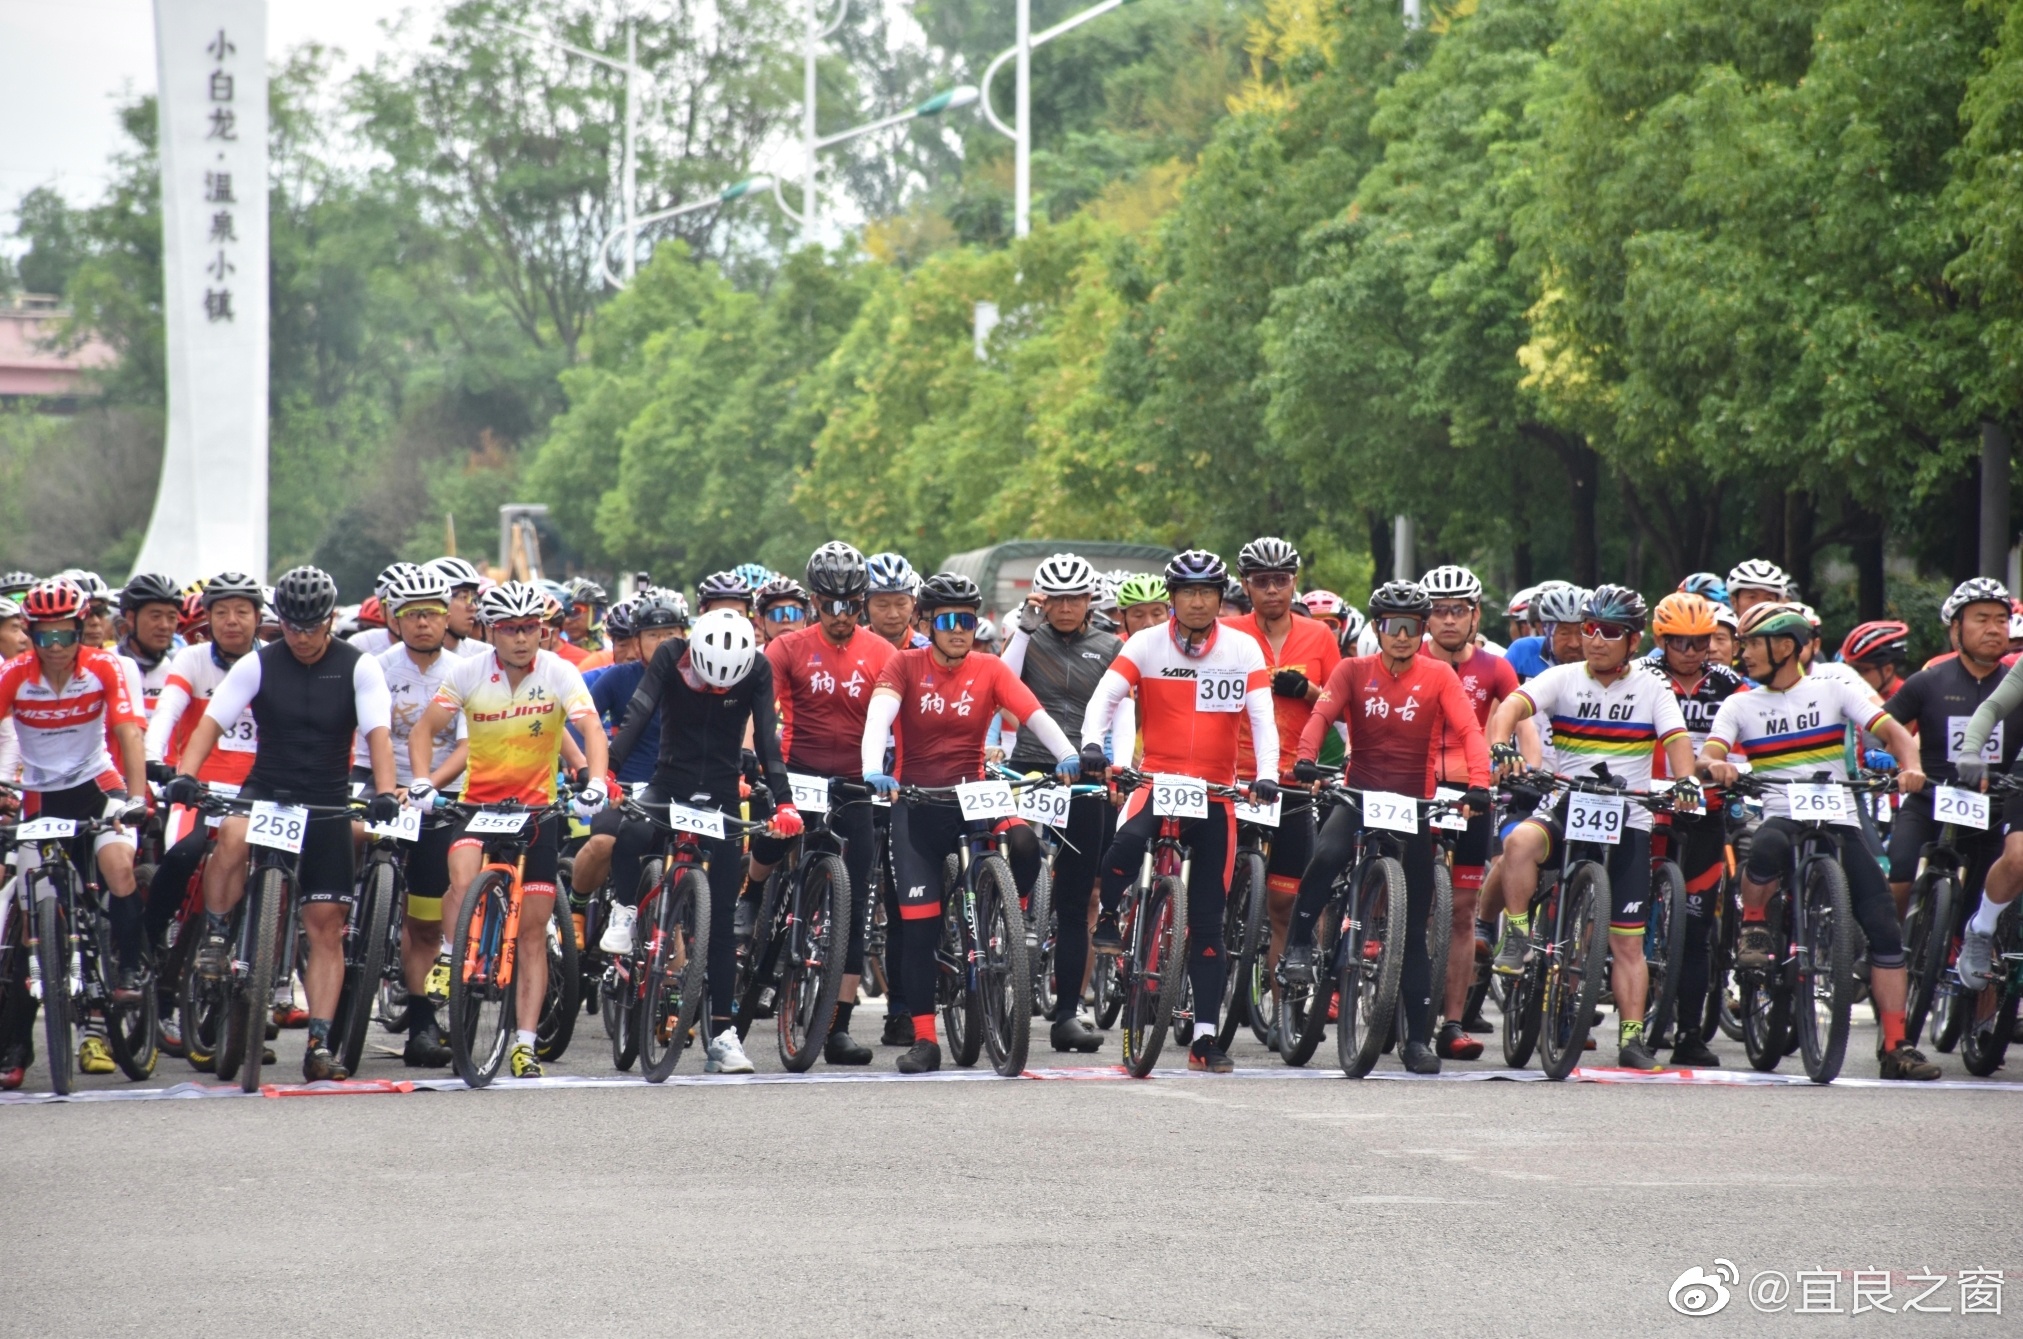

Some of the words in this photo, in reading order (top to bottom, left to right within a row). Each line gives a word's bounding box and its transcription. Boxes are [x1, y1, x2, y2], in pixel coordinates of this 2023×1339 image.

[1201, 679, 1245, 701] 309
[15, 700, 102, 721] MISSILE
[1577, 702, 1600, 717] NA
[1609, 705, 1634, 721] GU
[528, 720, 544, 737] 京
[1766, 719, 1789, 735] NA
[1797, 711, 1820, 728] GU
[964, 792, 1010, 811] 252
[1024, 792, 1066, 816] 350
[1158, 787, 1204, 808] 309
[1794, 791, 1841, 811] 265
[1368, 802, 1413, 822] 374
[1939, 798, 1985, 820] 205
[21, 822, 71, 832] 210
[252, 814, 300, 841] 258
[472, 818, 520, 828] 356
[675, 815, 719, 831] 204
[1571, 809, 1618, 832] 349
